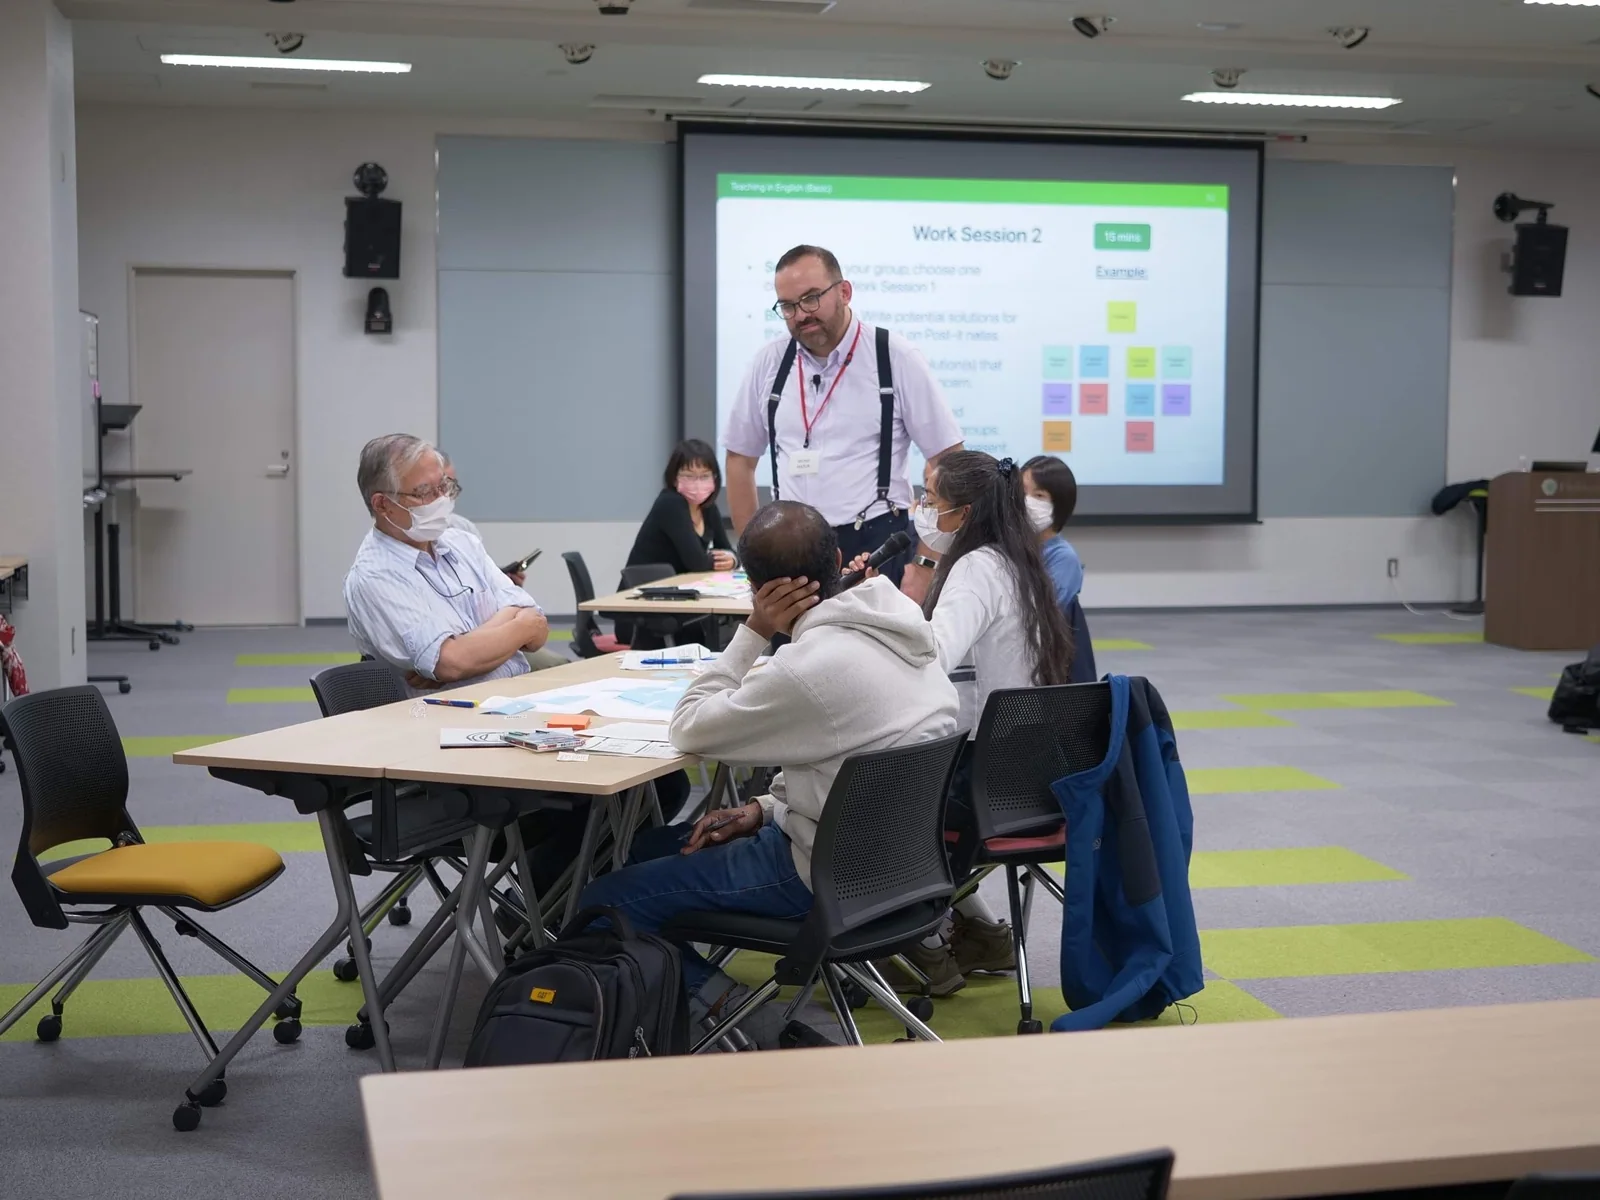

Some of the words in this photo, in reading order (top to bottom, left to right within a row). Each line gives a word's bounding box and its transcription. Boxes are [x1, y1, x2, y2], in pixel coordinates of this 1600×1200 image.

[731, 182, 766, 194] Teaching
[775, 183, 803, 195] English
[913, 225, 957, 241] Work
[961, 226, 1027, 243] Session
[1032, 228, 1042, 243] 2
[1104, 231, 1117, 242] 15
[1118, 232, 1142, 243] mins
[1096, 265, 1147, 280] Example
[881, 281, 927, 292] Session
